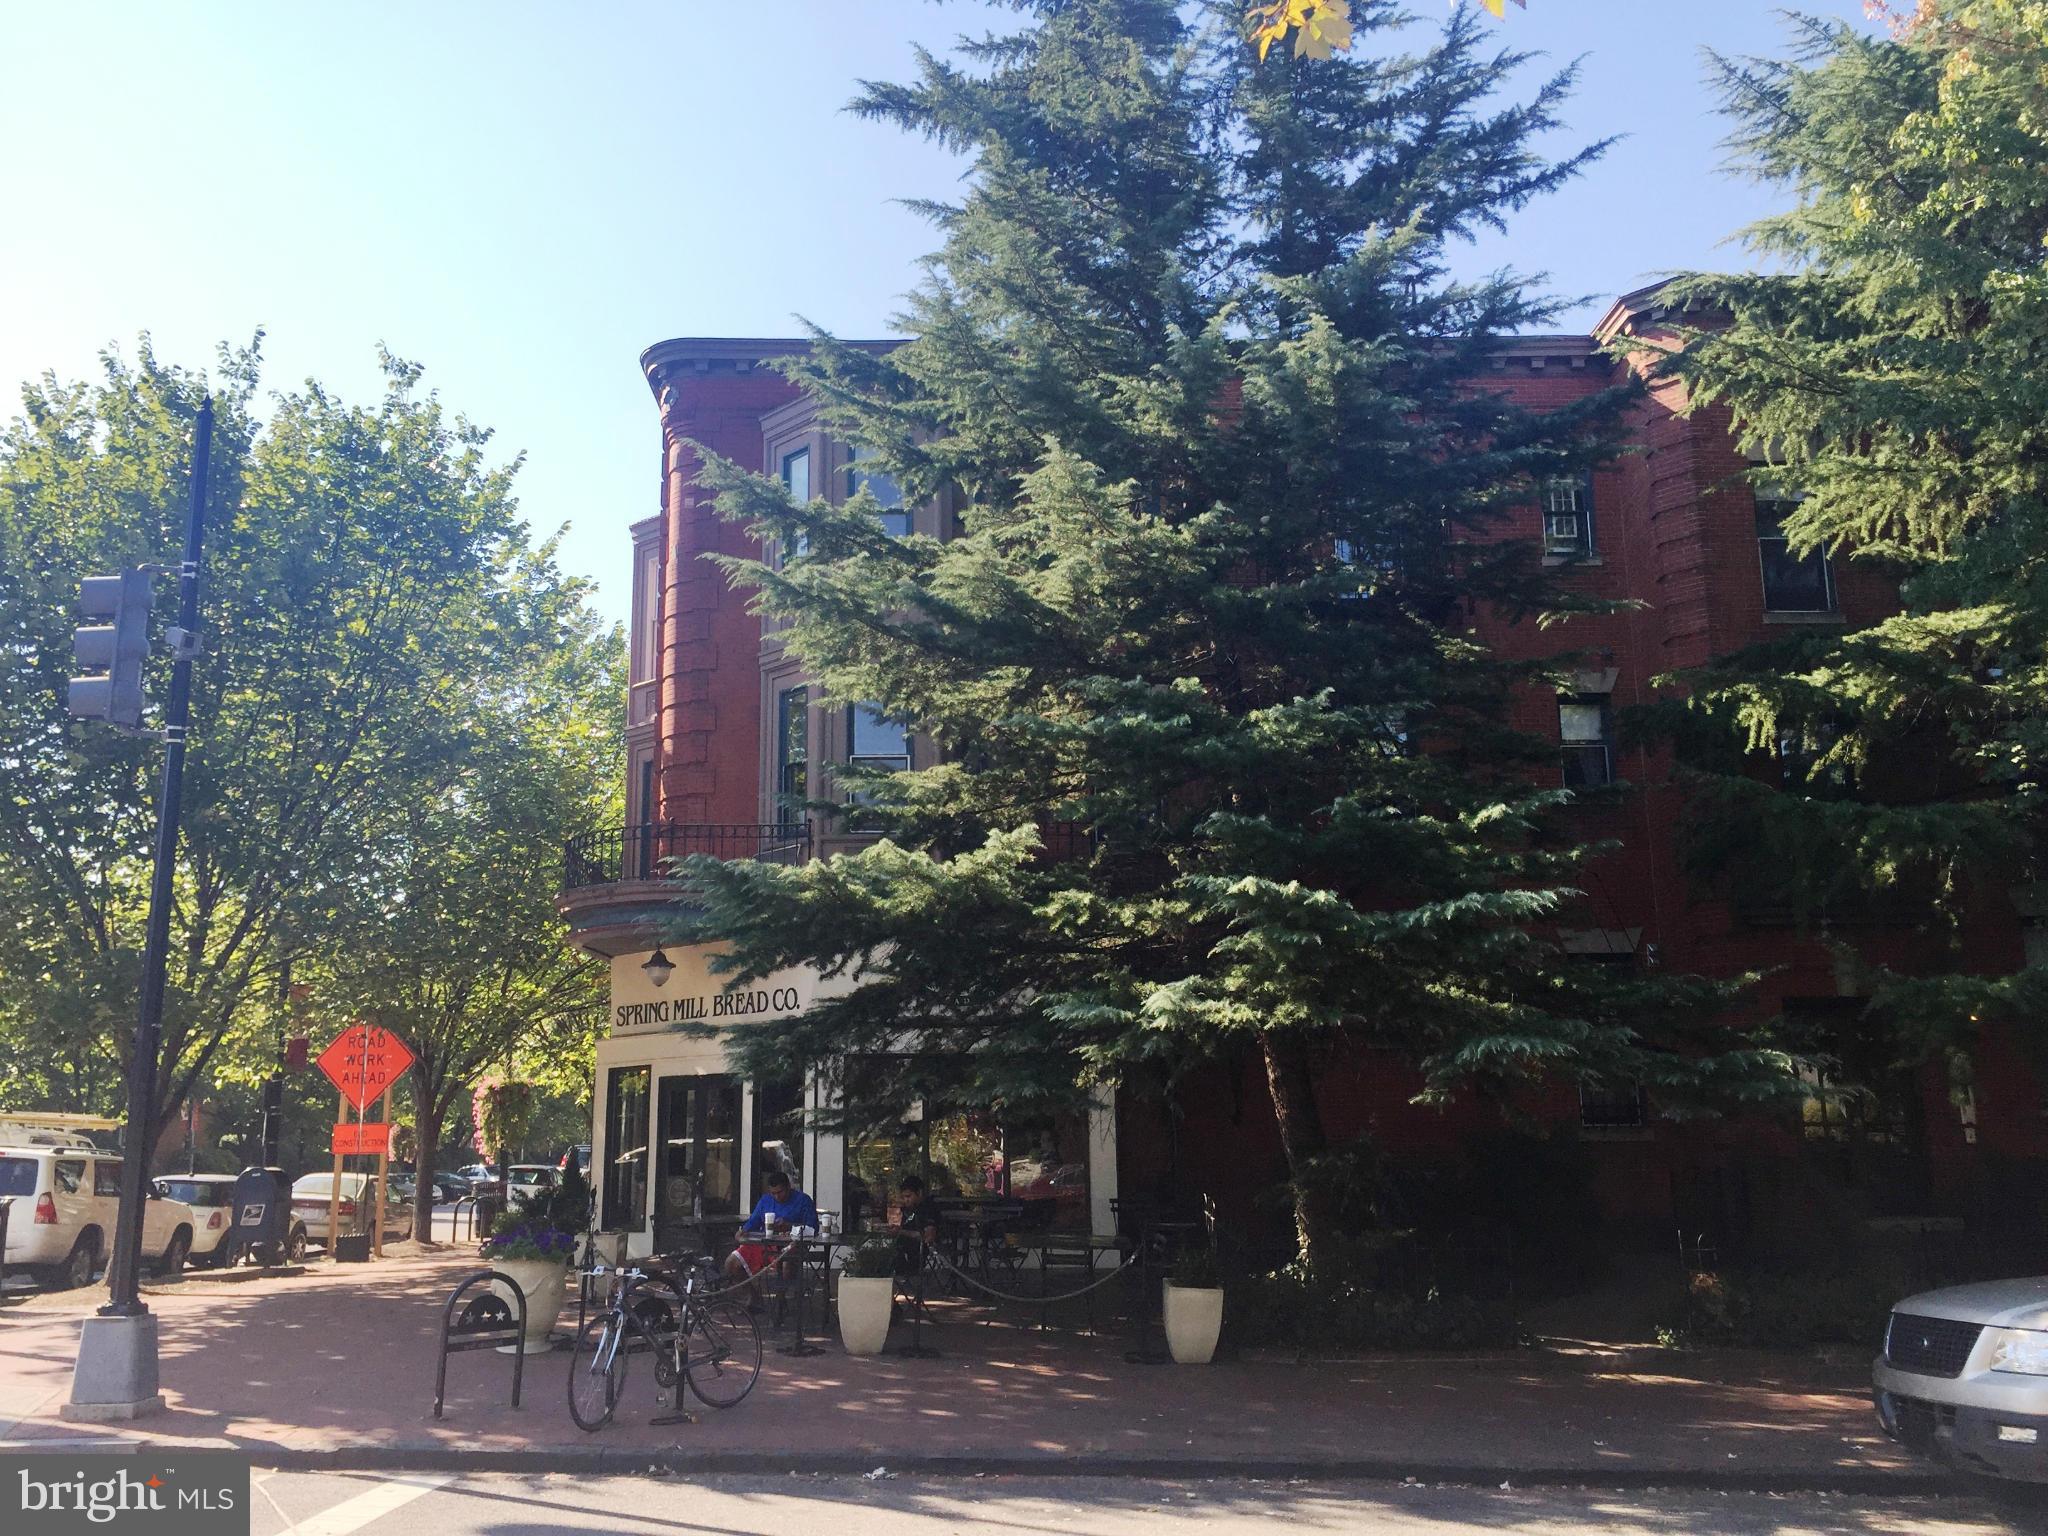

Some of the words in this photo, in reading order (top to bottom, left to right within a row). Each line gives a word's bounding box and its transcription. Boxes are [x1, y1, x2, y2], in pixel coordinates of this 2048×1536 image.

[616, 1000, 669, 1027] SPRING
[673, 996, 708, 1020] MILL
[712, 991, 768, 1017] BREAD
[772, 987, 800, 1012] CO.
[348, 1036, 386, 1048] ROAD
[346, 1053, 385, 1066] WORK
[334, 1137, 387, 1148] CONSTUCTION
